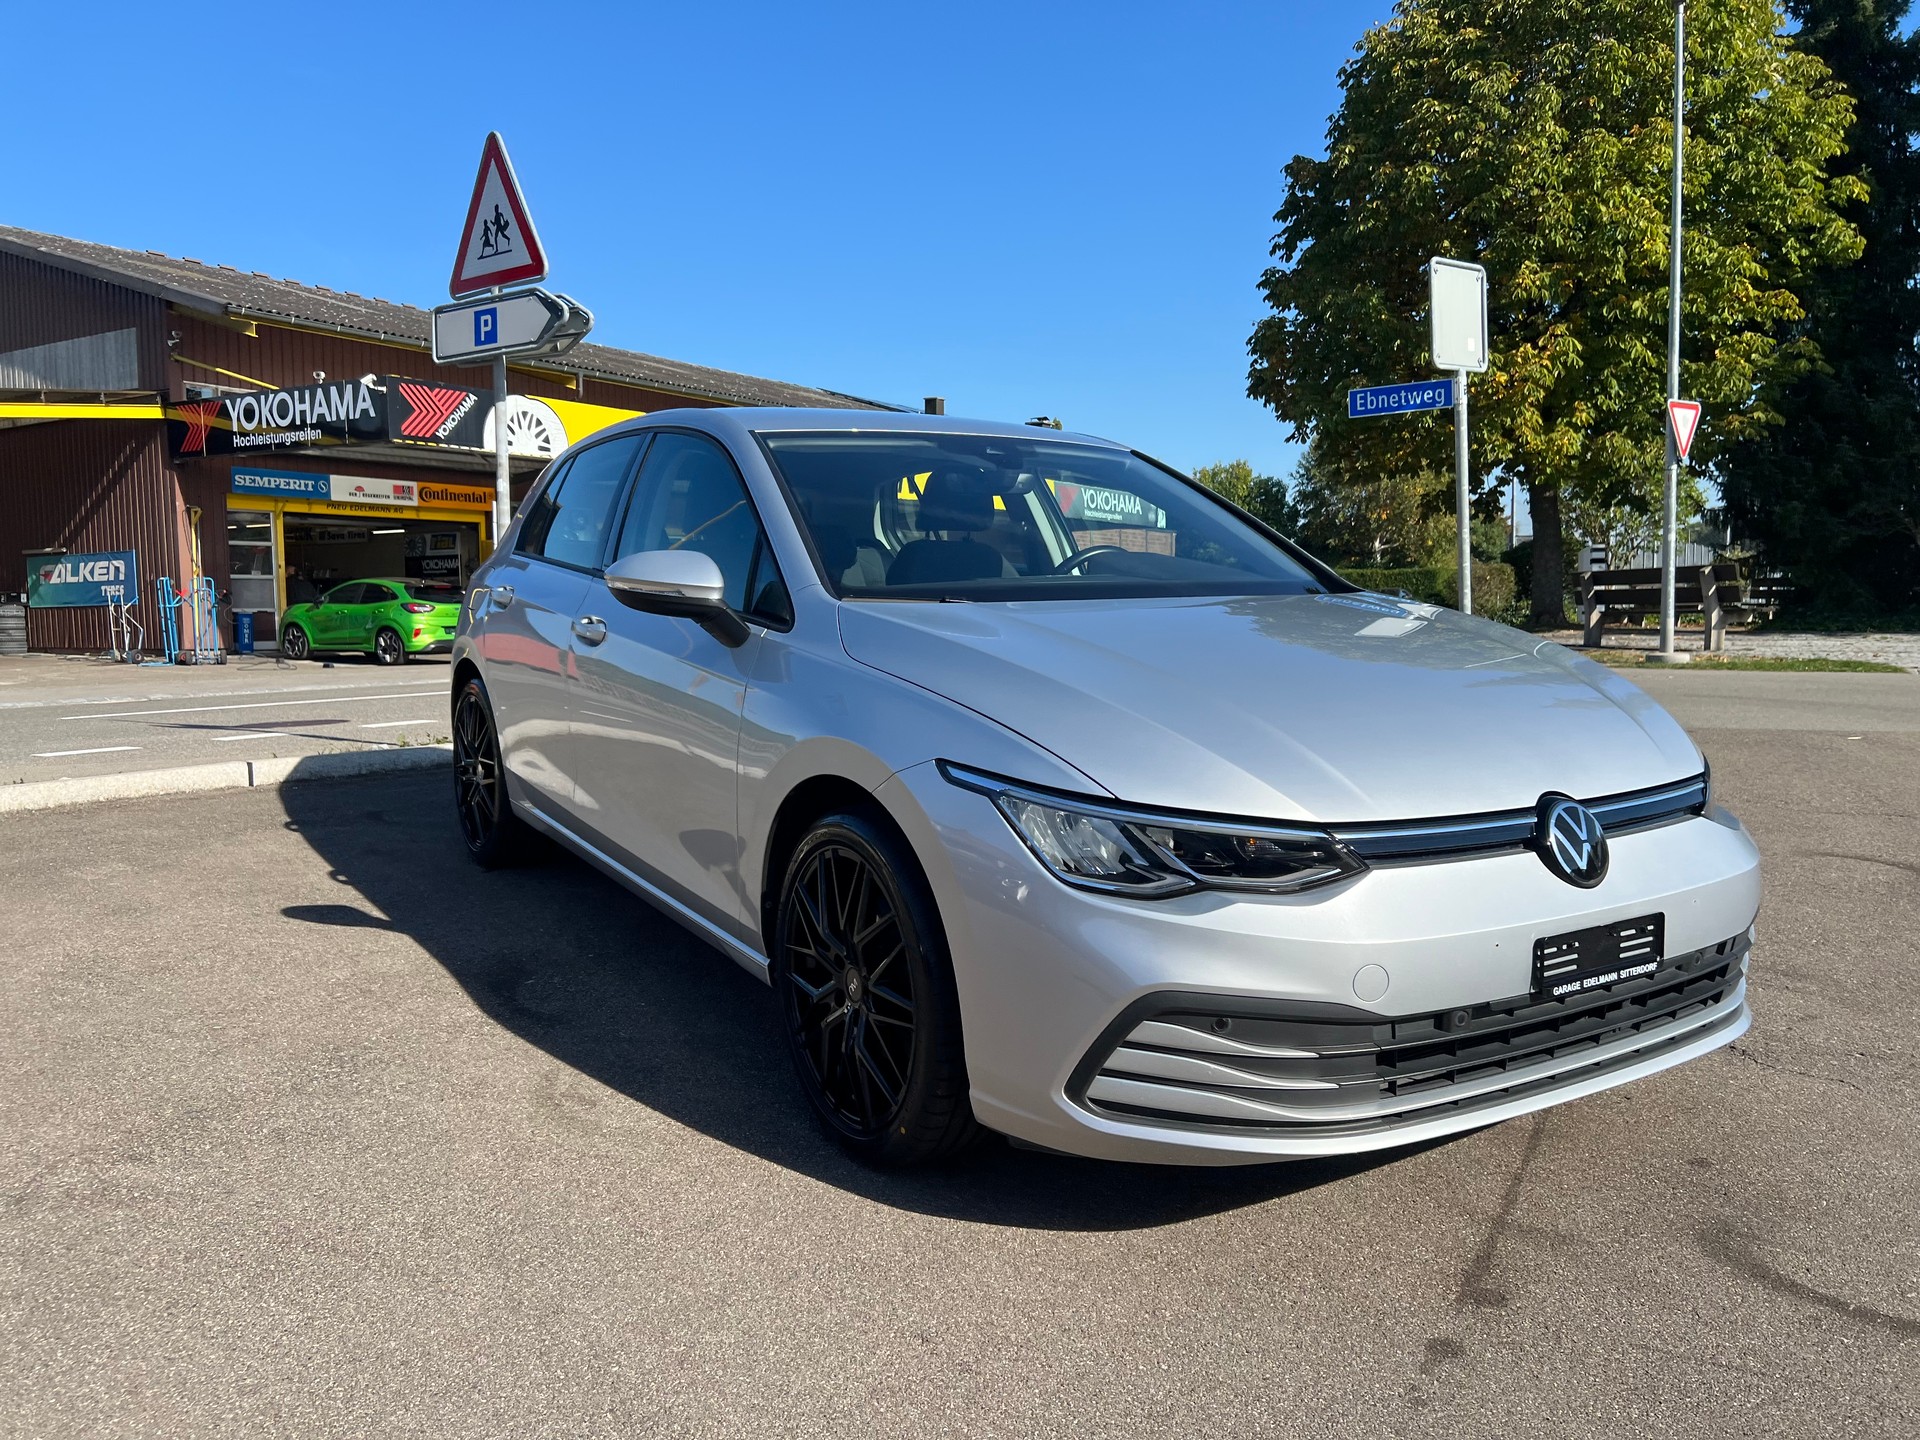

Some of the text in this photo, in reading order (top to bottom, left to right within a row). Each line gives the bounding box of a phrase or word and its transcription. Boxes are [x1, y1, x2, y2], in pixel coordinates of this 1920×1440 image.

[480, 314, 492, 341] P
[224, 383, 376, 431] YOKOHAMA
[1356, 388, 1445, 411] Ebnetweg
[435, 392, 478, 440] YOKOHAMA
[233, 428, 322, 447] Hochleistungsreifen
[234, 474, 315, 492] SEMPERIT
[419, 486, 487, 504] Continental
[1081, 488, 1142, 515] YOKOHAMA
[326, 503, 347, 511] PNEU
[350, 504, 391, 513] EDELMANN
[39, 560, 125, 584] FALKEN
[421, 558, 459, 570] YOKOHAMA
[1553, 962, 1658, 996] GARAGE EDELMANN SITTERDORF
